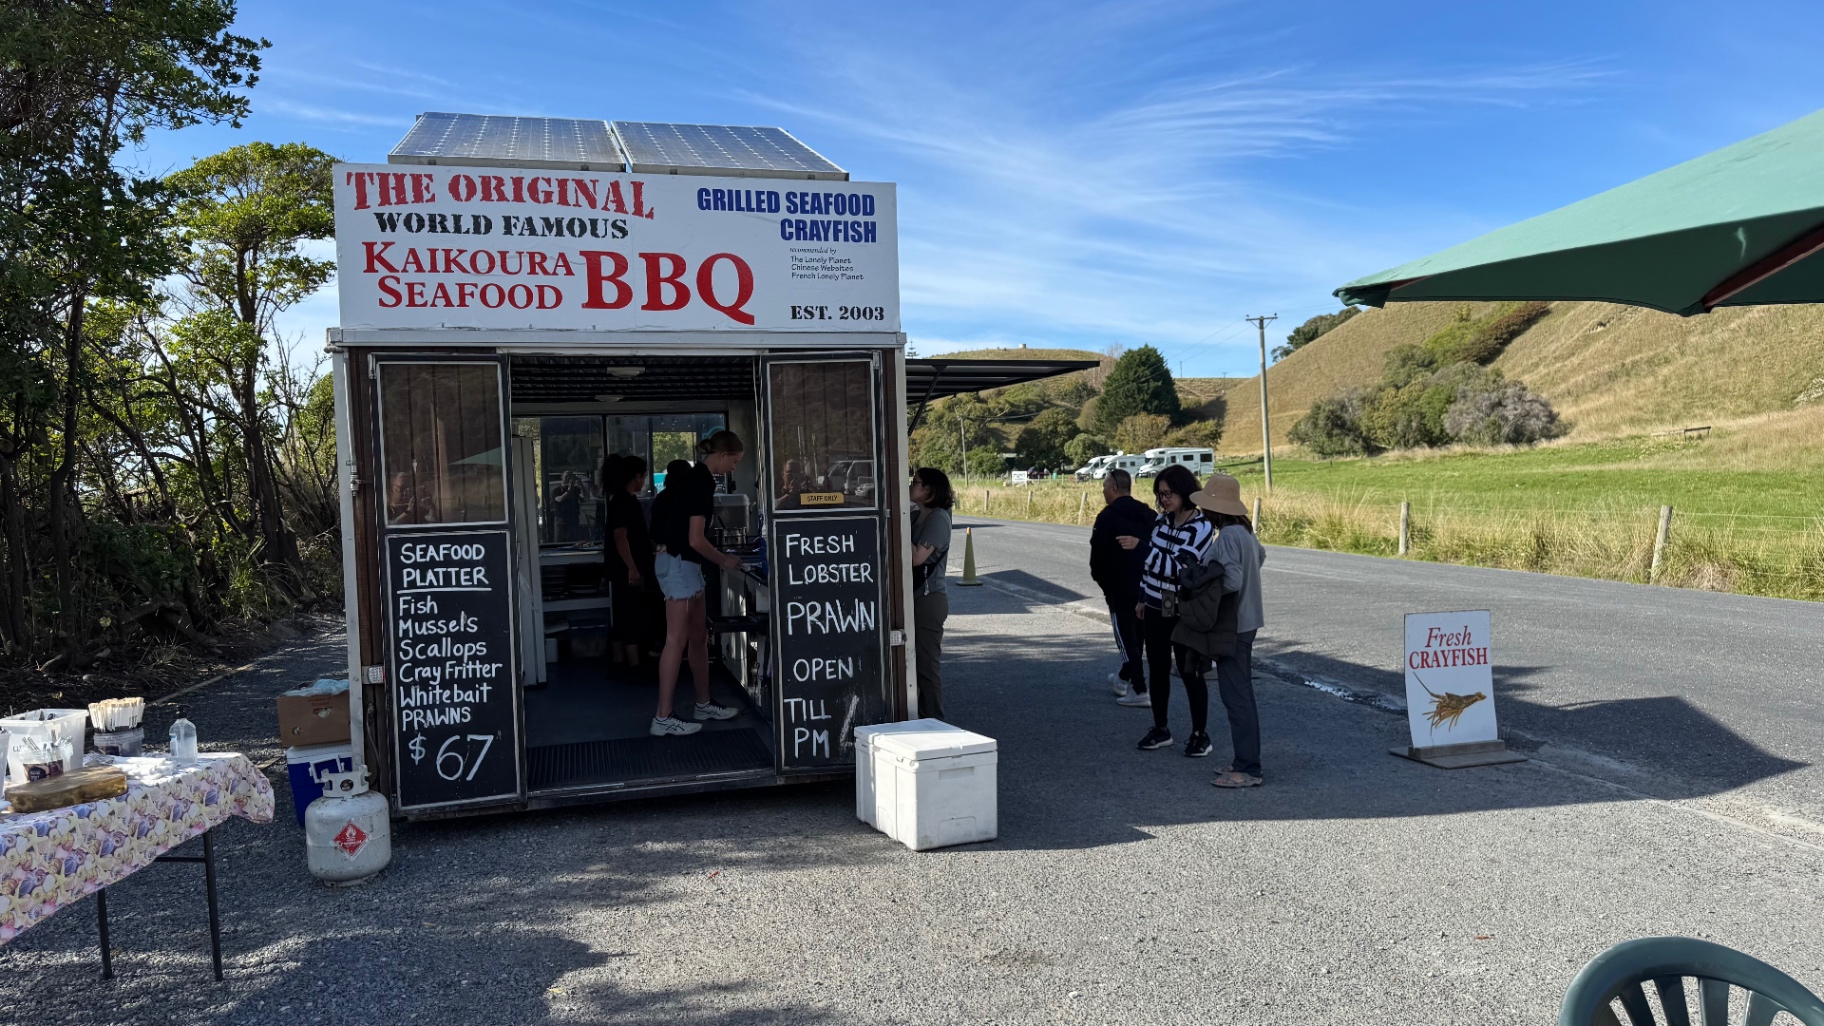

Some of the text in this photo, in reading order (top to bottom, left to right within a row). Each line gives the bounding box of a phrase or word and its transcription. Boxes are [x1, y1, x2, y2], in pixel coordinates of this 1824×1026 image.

[346, 172, 654, 220] THE ORIGINAL
[697, 187, 875, 217] GRILLED SEAFOOD
[373, 212, 629, 240] WORLD FAMOUS
[780, 218, 877, 243] CRAYFISH
[361, 241, 575, 276] KAIKOURA
[790, 255, 852, 265] The Lonely Planet
[829, 247, 837, 255] by
[791, 271, 816, 279] French
[817, 272, 840, 281] Lonely
[820, 264, 854, 272] Websites
[378, 275, 563, 310] SEAFOOD
[579, 250, 755, 325] BBQ
[790, 305, 885, 320] EST. 2003
[400, 543, 485, 564] SEAFOOD
[786, 533, 854, 558] FRESH
[403, 567, 489, 588] PLATTER
[788, 562, 874, 585] LOBSTER
[399, 595, 438, 616] Fish
[787, 598, 875, 635] PRAWN
[399, 610, 478, 638] Mussels
[1424, 625, 1472, 647] Fresh
[399, 637, 487, 663] Scallops
[1409, 647, 1488, 669] CRAYFISH
[399, 660, 503, 685] Cray Fritter
[793, 656, 853, 681] OPEN
[399, 682, 492, 708] Whitebait
[402, 706, 471, 731] PRAWNS
[784, 698, 832, 723] TILL
[795, 727, 829, 758] PM
[436, 734, 494, 781] 67
